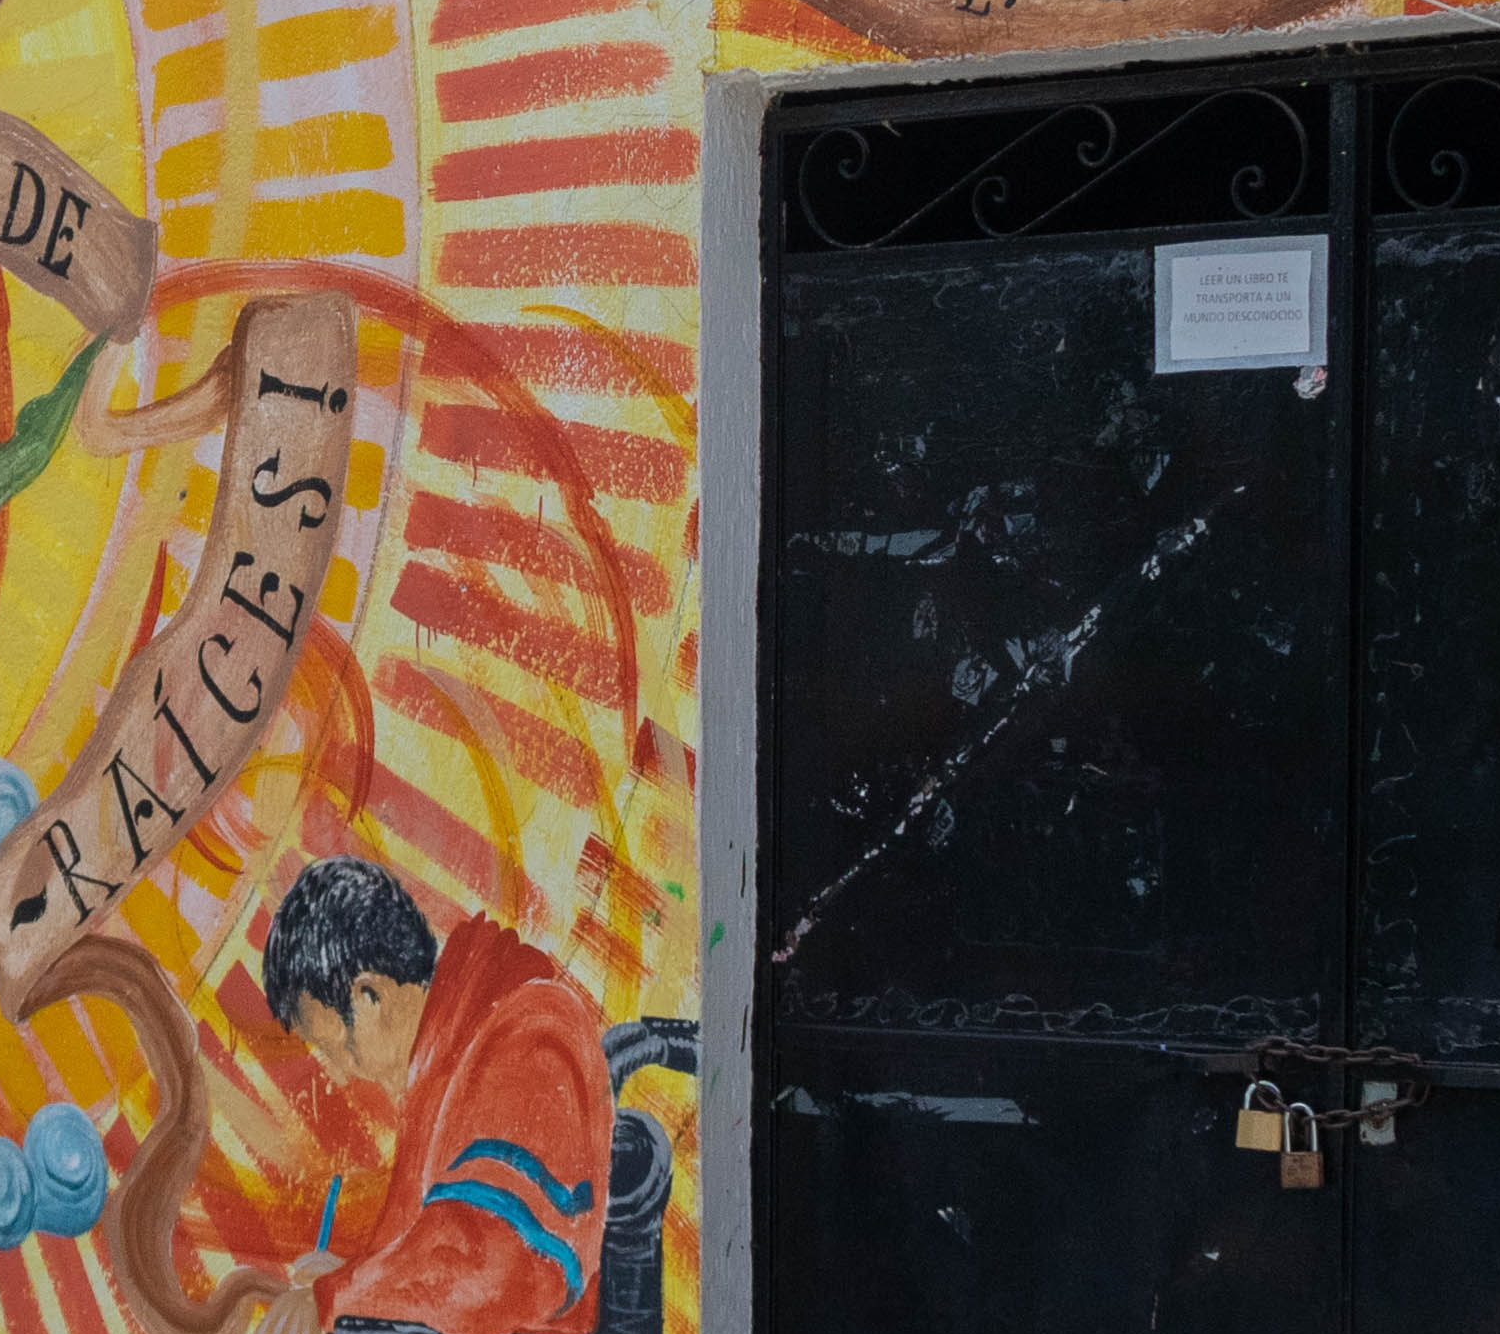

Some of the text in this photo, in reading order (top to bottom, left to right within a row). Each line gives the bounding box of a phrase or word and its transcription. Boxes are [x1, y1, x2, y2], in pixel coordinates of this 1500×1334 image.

[1226, 273, 1241, 285] UN
[1244, 272, 1274, 284] LIBRO
[1277, 271, 1289, 283] TE
[1196, 290, 1291, 304] TRANSPORTA A UN
[1183, 309, 1303, 324] MUNDO DESCONOCIDO
